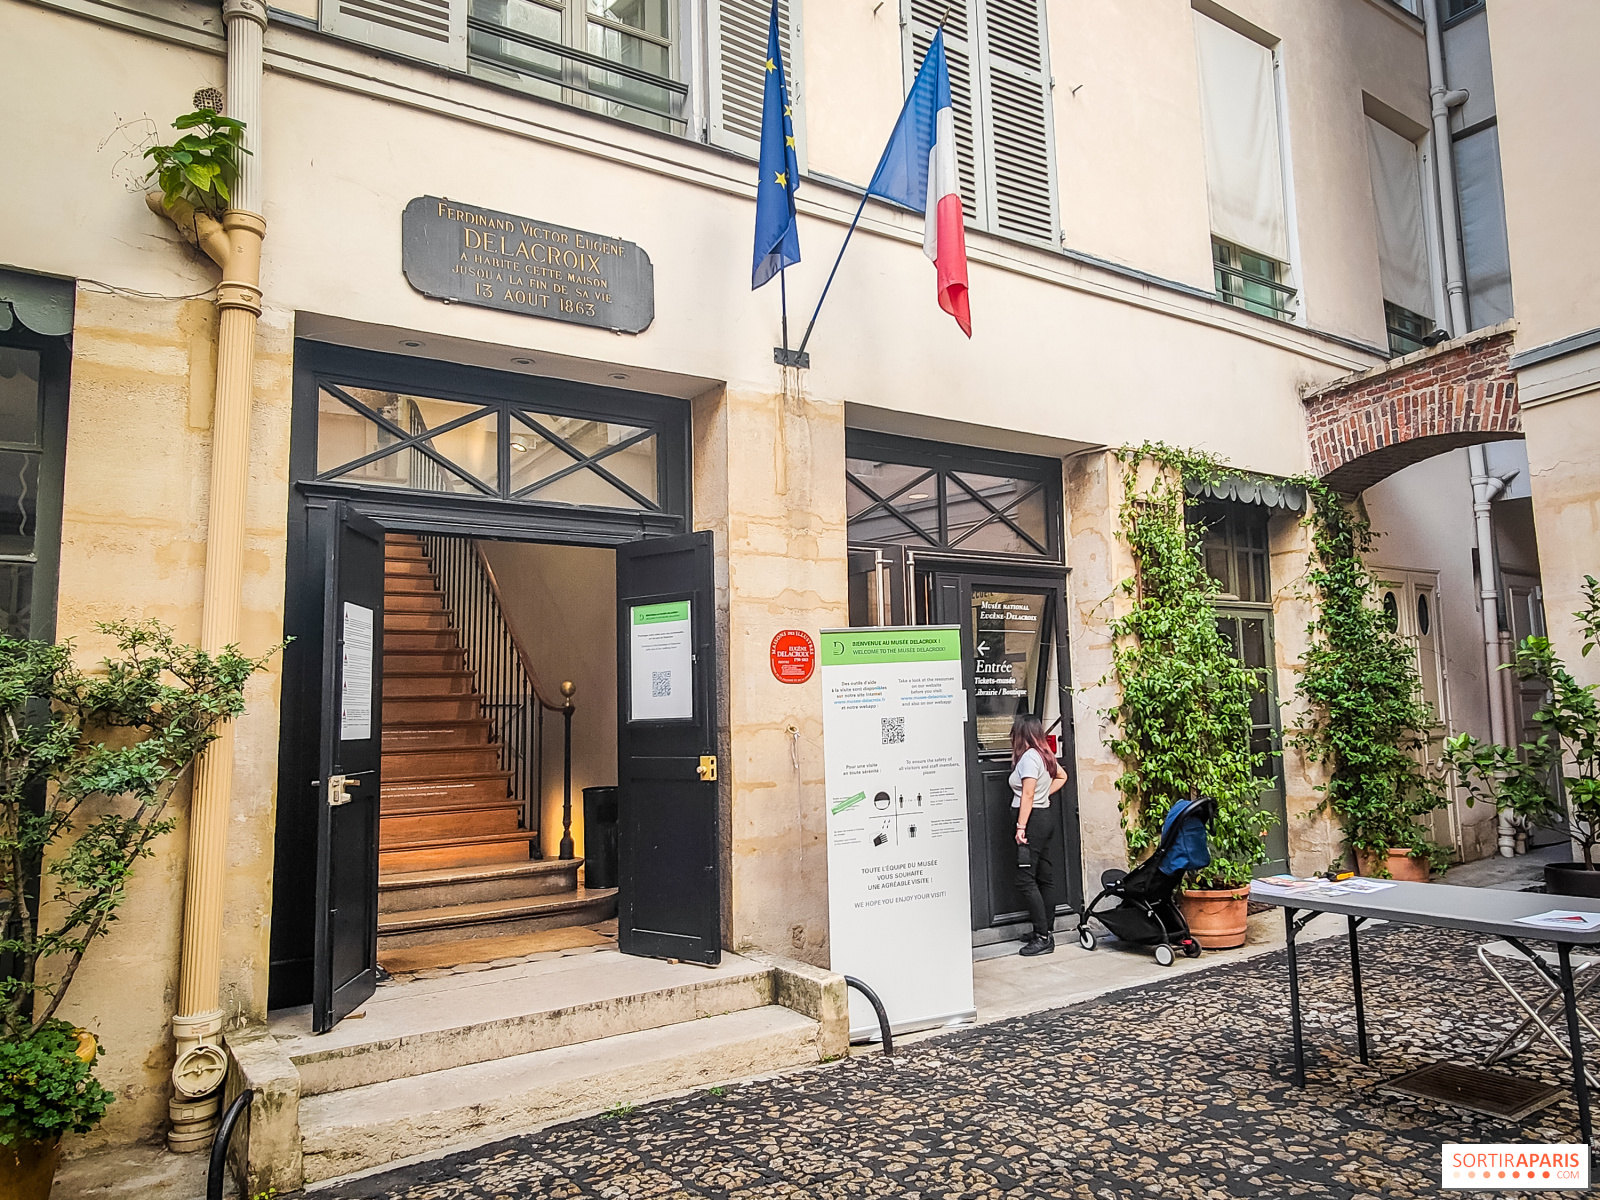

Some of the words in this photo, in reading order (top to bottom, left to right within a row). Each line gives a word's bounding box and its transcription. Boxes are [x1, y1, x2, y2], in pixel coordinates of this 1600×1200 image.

[438, 202, 516, 233] FERDINAND
[520, 222, 569, 244] VICTOR
[464, 228, 600, 275] DELACROIX
[460, 252, 468, 262] A
[474, 254, 520, 272] HABITE
[525, 264, 562, 280] CETTE
[568, 272, 608, 288] MAISON
[475, 282, 493, 298] 13
[504, 289, 550, 308] AOUT
[560, 298, 596, 317] 1863
[510, 275, 523, 286] LA
[530, 278, 547, 290] FIN
[554, 284, 568, 294] DE
[576, 288, 589, 298] SA
[595, 292, 612, 304] VIE
[976, 660, 1012, 673] Entrée
[1002, 688, 1027, 697] Boutique
[882, 863, 906, 871] L'ÉQUIPE
[895, 870, 923, 878] SOUHAITE
[881, 880, 910, 889] AGRÉABLE
